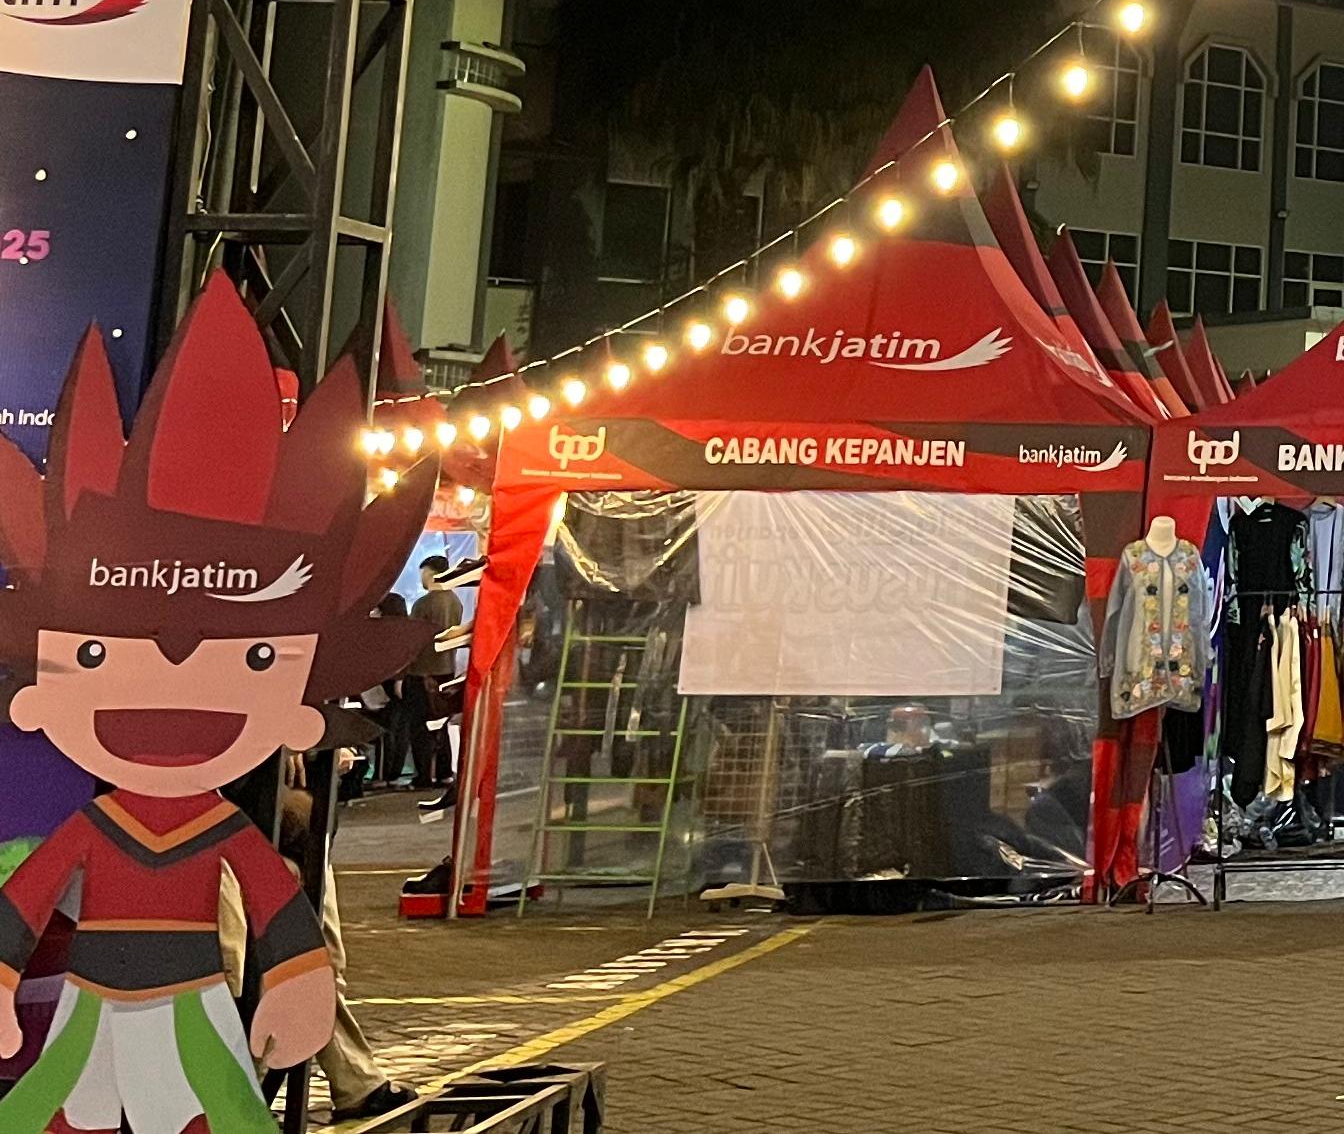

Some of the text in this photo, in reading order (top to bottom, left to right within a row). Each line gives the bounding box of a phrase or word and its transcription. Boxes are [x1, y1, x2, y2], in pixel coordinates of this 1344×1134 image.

[720, 326, 942, 364] bankjatim
[703, 436, 967, 467] CABANG KEPANJEN
[1018, 443, 1102, 469] bankjatim
[89, 557, 258, 595] bankjatim
